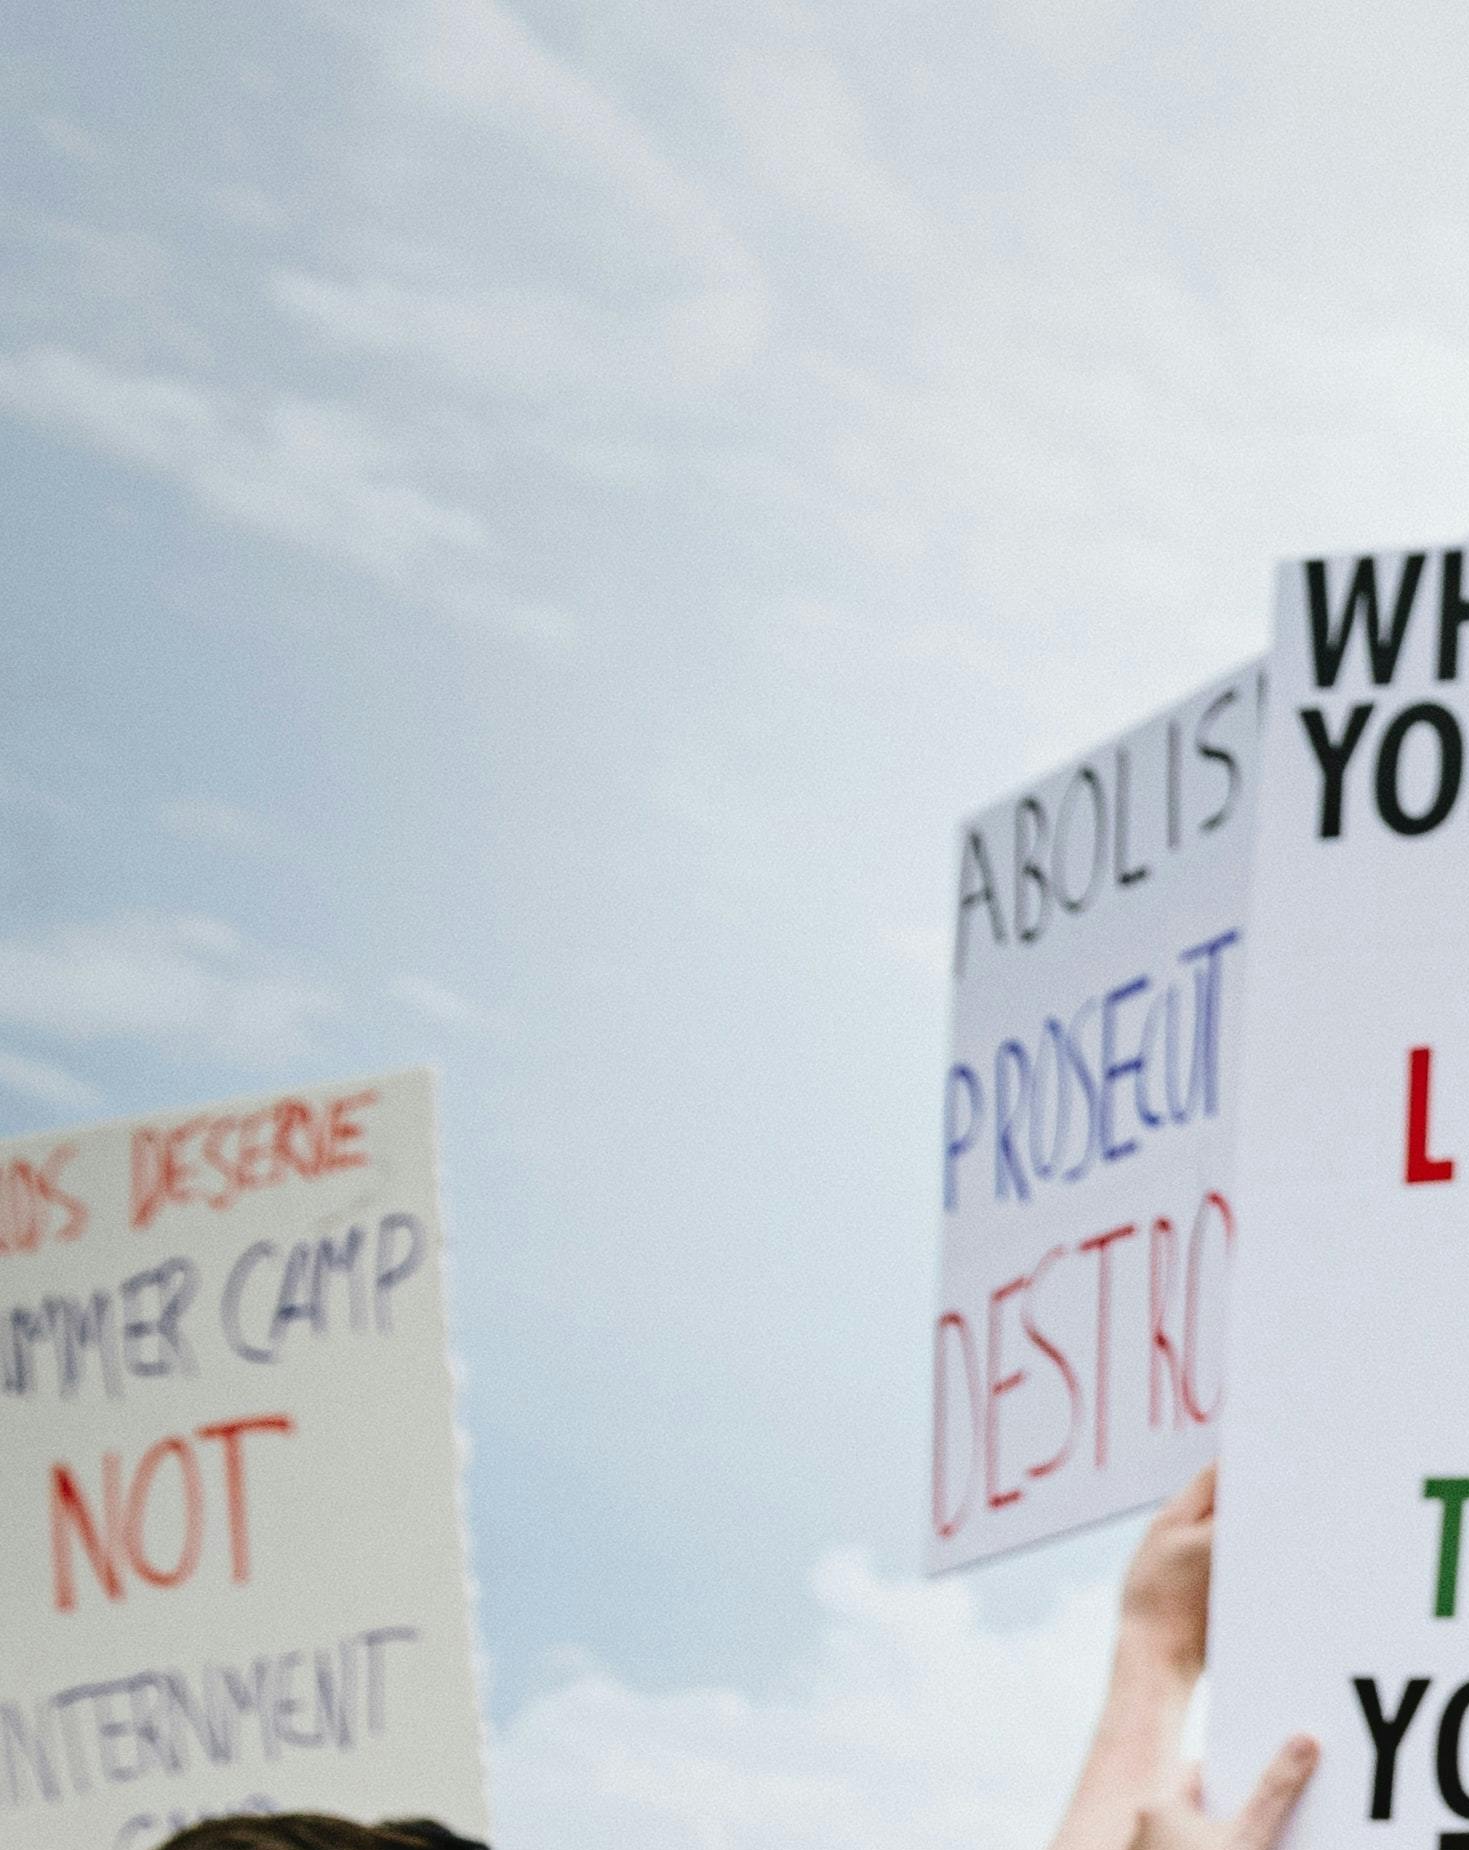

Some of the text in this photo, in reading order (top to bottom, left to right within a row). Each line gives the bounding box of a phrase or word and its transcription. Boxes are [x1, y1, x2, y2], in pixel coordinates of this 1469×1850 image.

[952, 668, 1266, 978] ABOLIS
[942, 924, 1240, 1213] PROSECUT
[0, 1212, 427, 1400] MMER CAMP
[932, 1190, 1238, 1541] DESTRO
[50, 1415, 297, 1614] NOT
[0, 1625, 420, 1803] NTERNMENT
